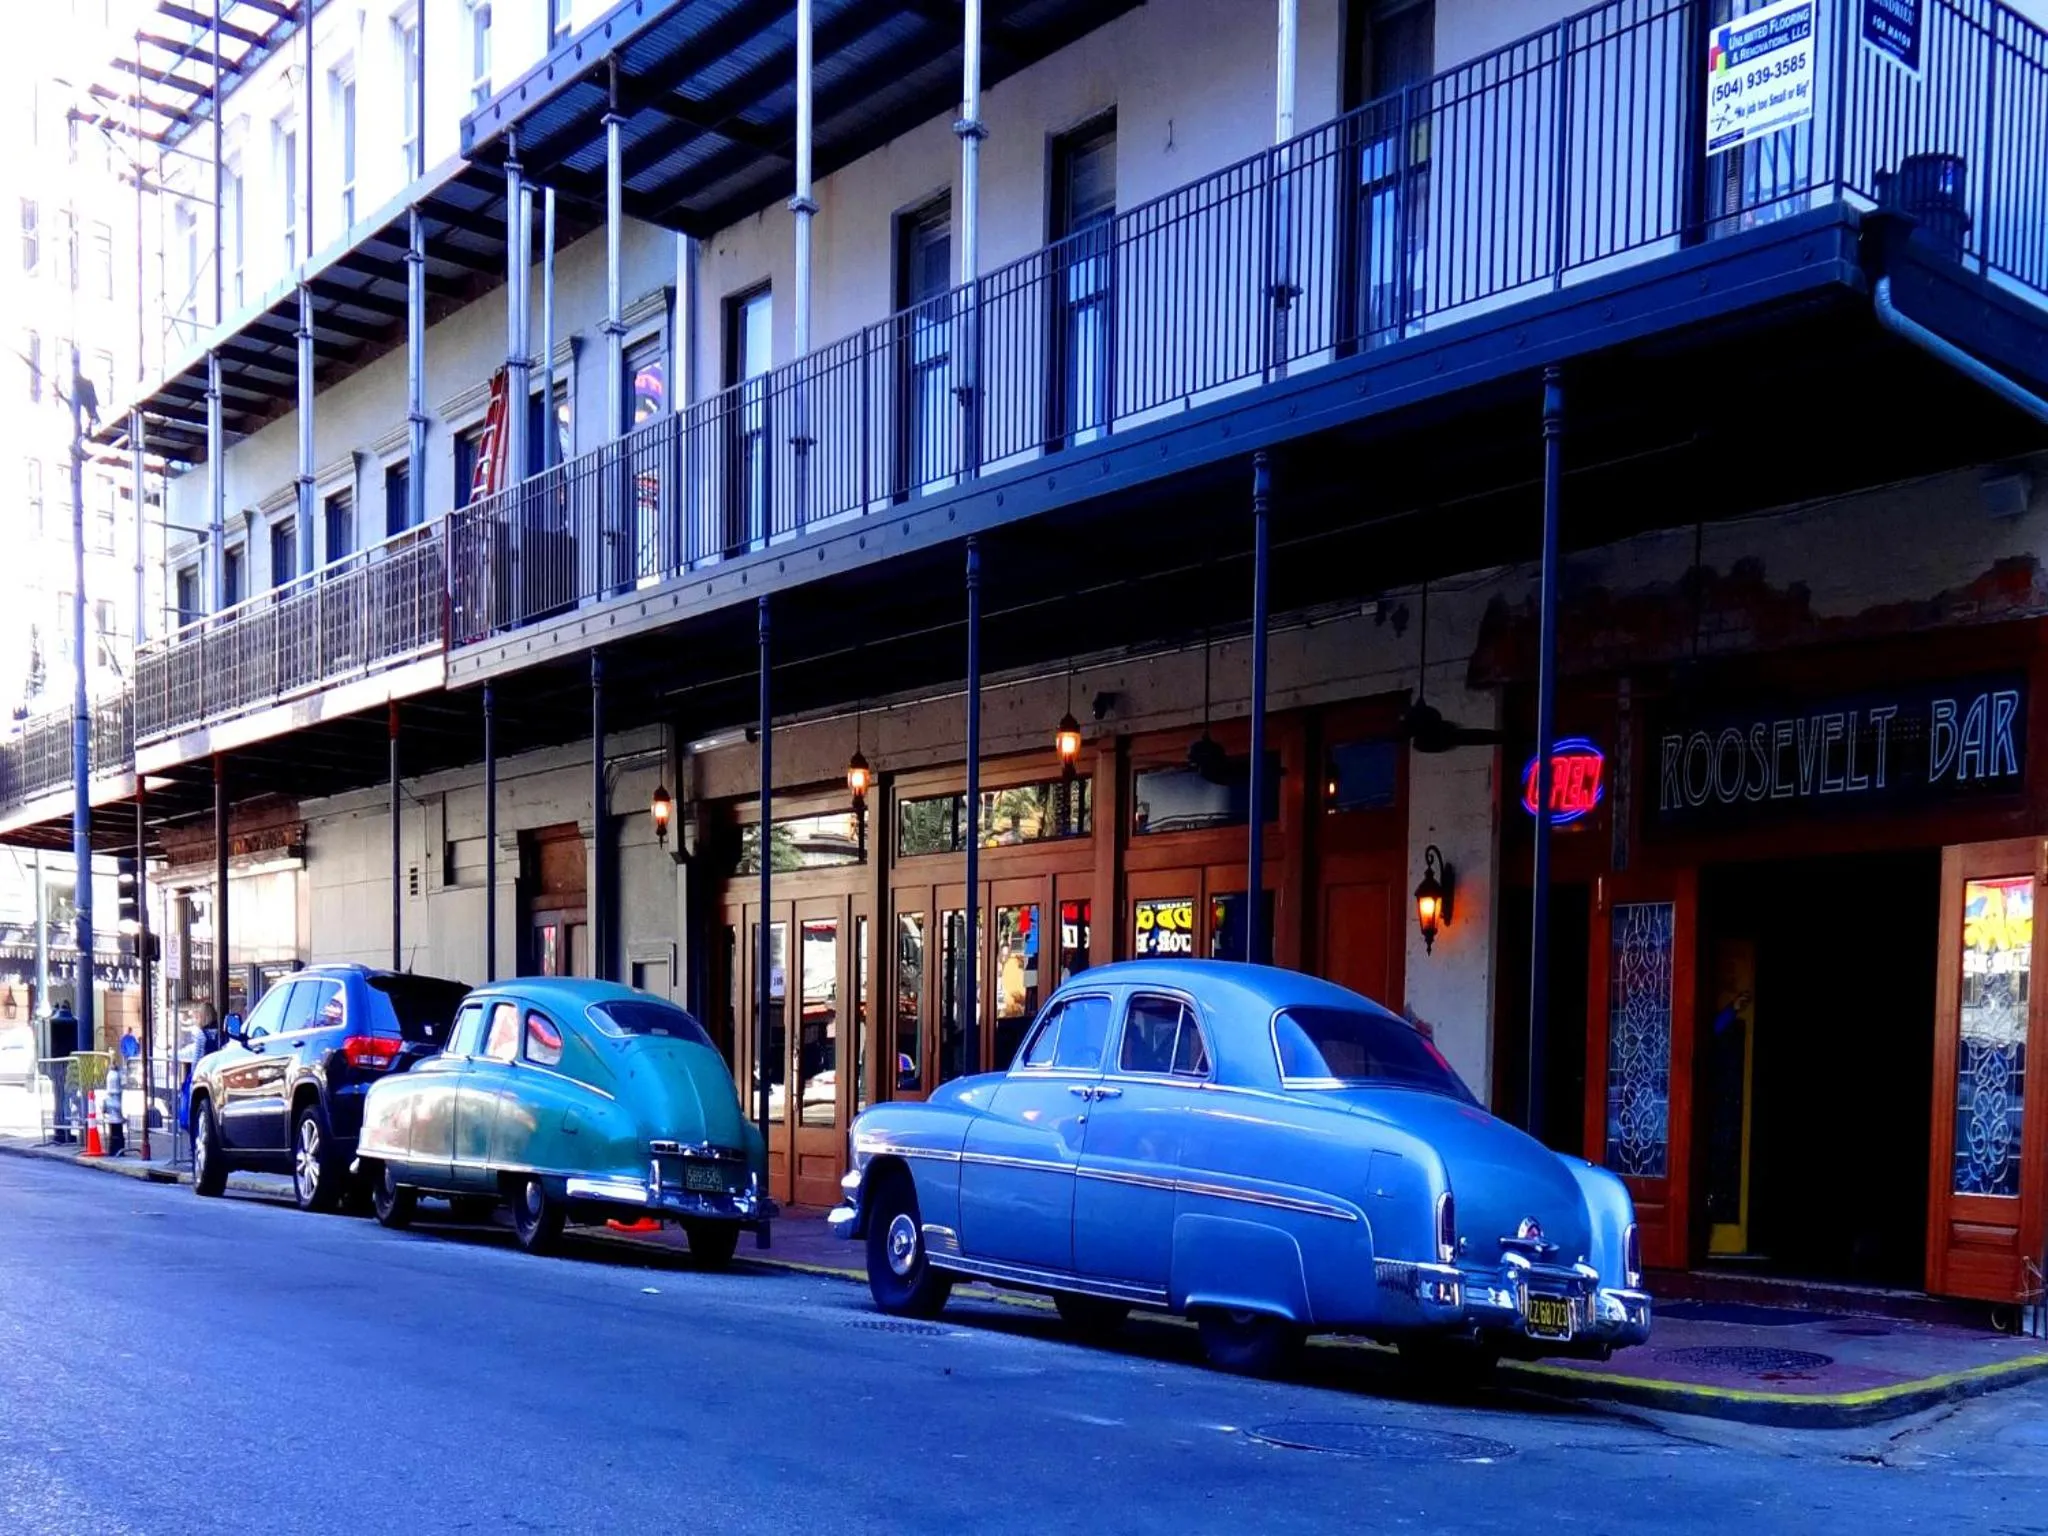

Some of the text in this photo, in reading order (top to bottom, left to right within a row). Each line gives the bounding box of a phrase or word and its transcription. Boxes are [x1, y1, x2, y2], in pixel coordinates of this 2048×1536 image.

[1729, 8, 1809, 51] UNLIMITED FLOORING
[1732, 52, 1738, 63] &
[1792, 23, 1809, 40] LLC
[1872, 15, 1886, 32] FOR
[1888, 25, 1911, 48] MAYOR
[1712, 53, 1806, 107] (504) 939-3585
[1769, 89, 1786, 106] Small
[1659, 690, 2019, 810] ROOSEVELT BAR
